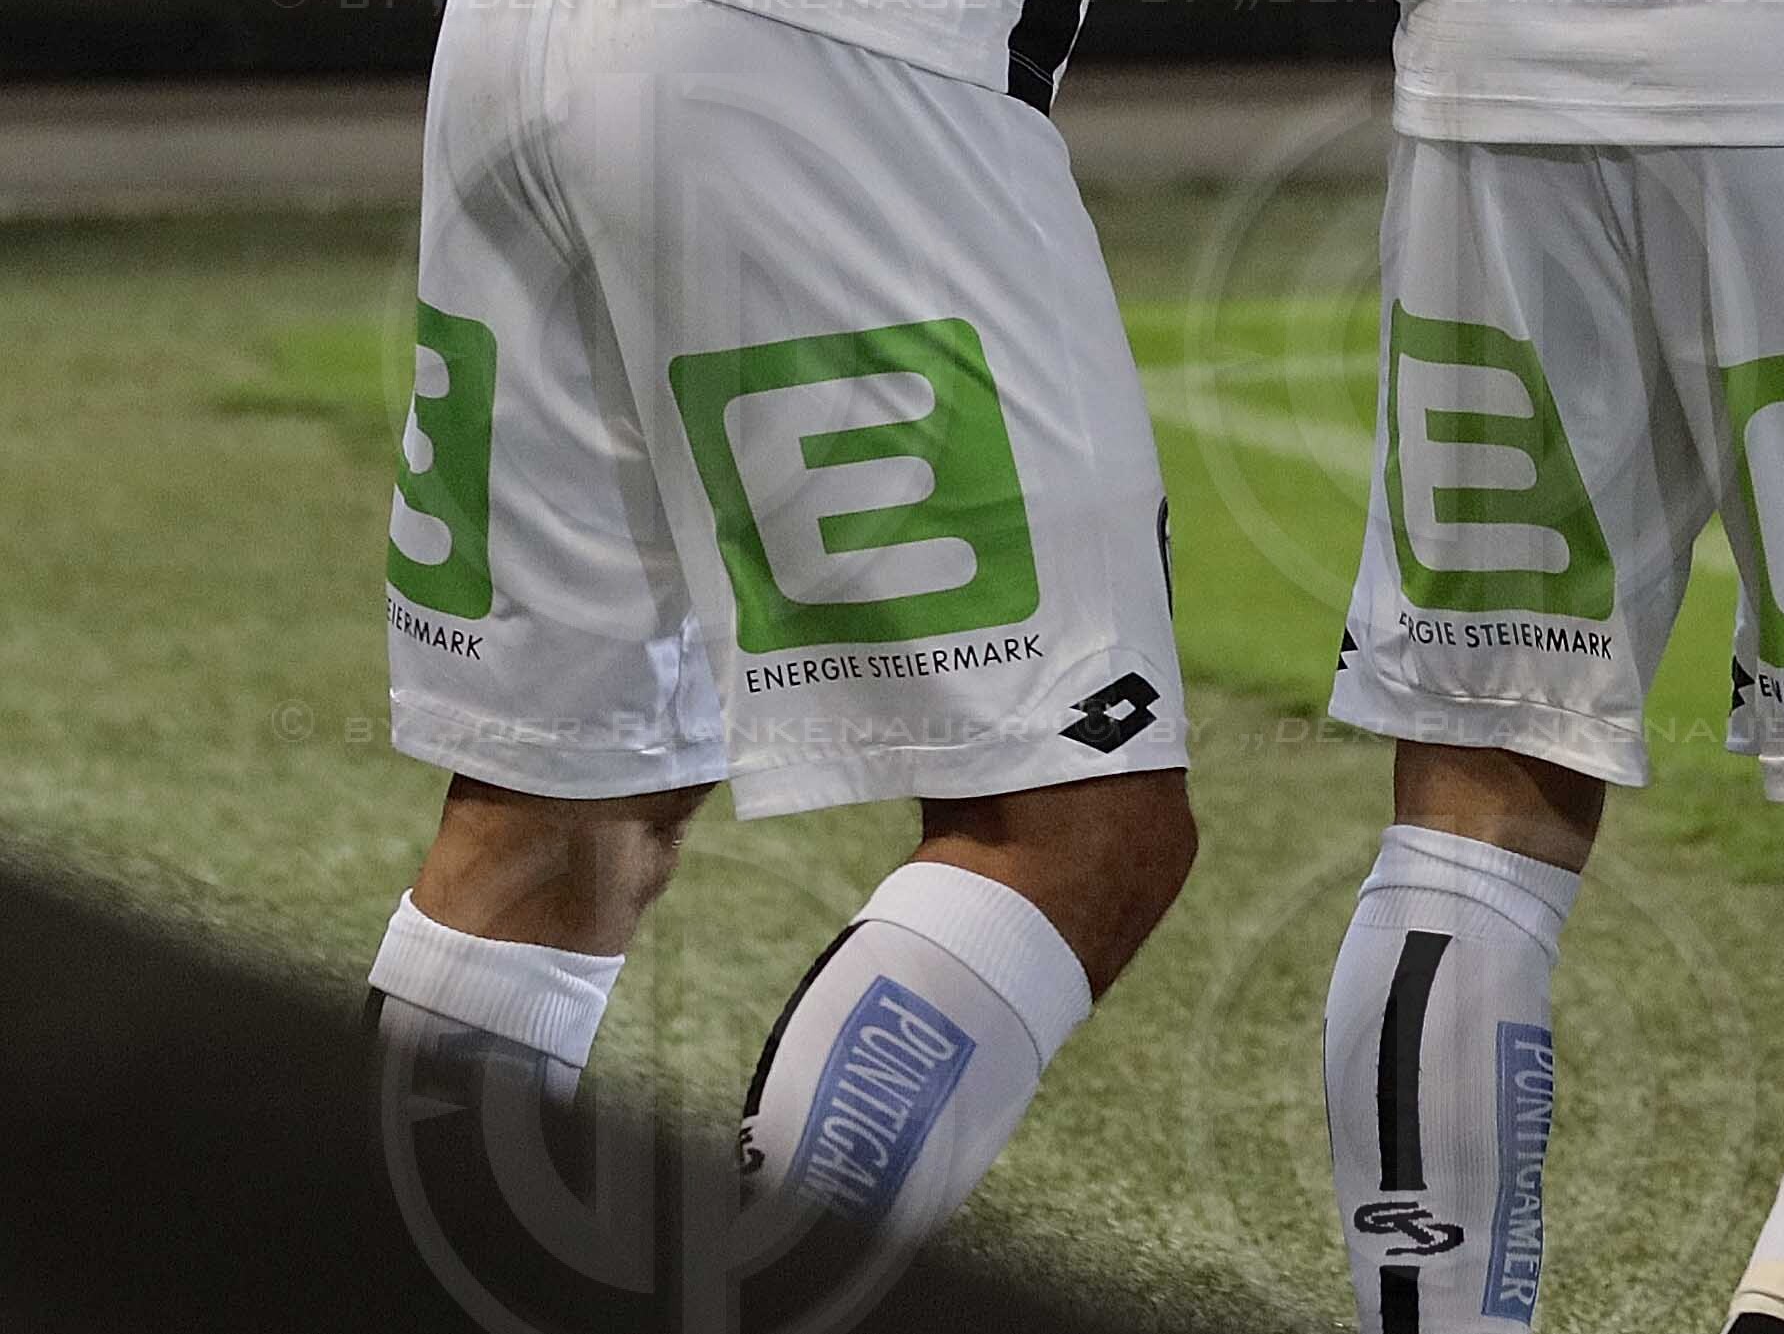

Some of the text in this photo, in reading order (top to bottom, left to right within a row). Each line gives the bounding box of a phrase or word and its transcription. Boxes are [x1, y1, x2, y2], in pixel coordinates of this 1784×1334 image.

[387, 597, 483, 661] EIERMARK
[1464, 622, 1612, 661] STEIERMARK
[746, 635, 1043, 694] ENERGIE STEIERMARK
[805, 996, 960, 1211] PUNTIGA
